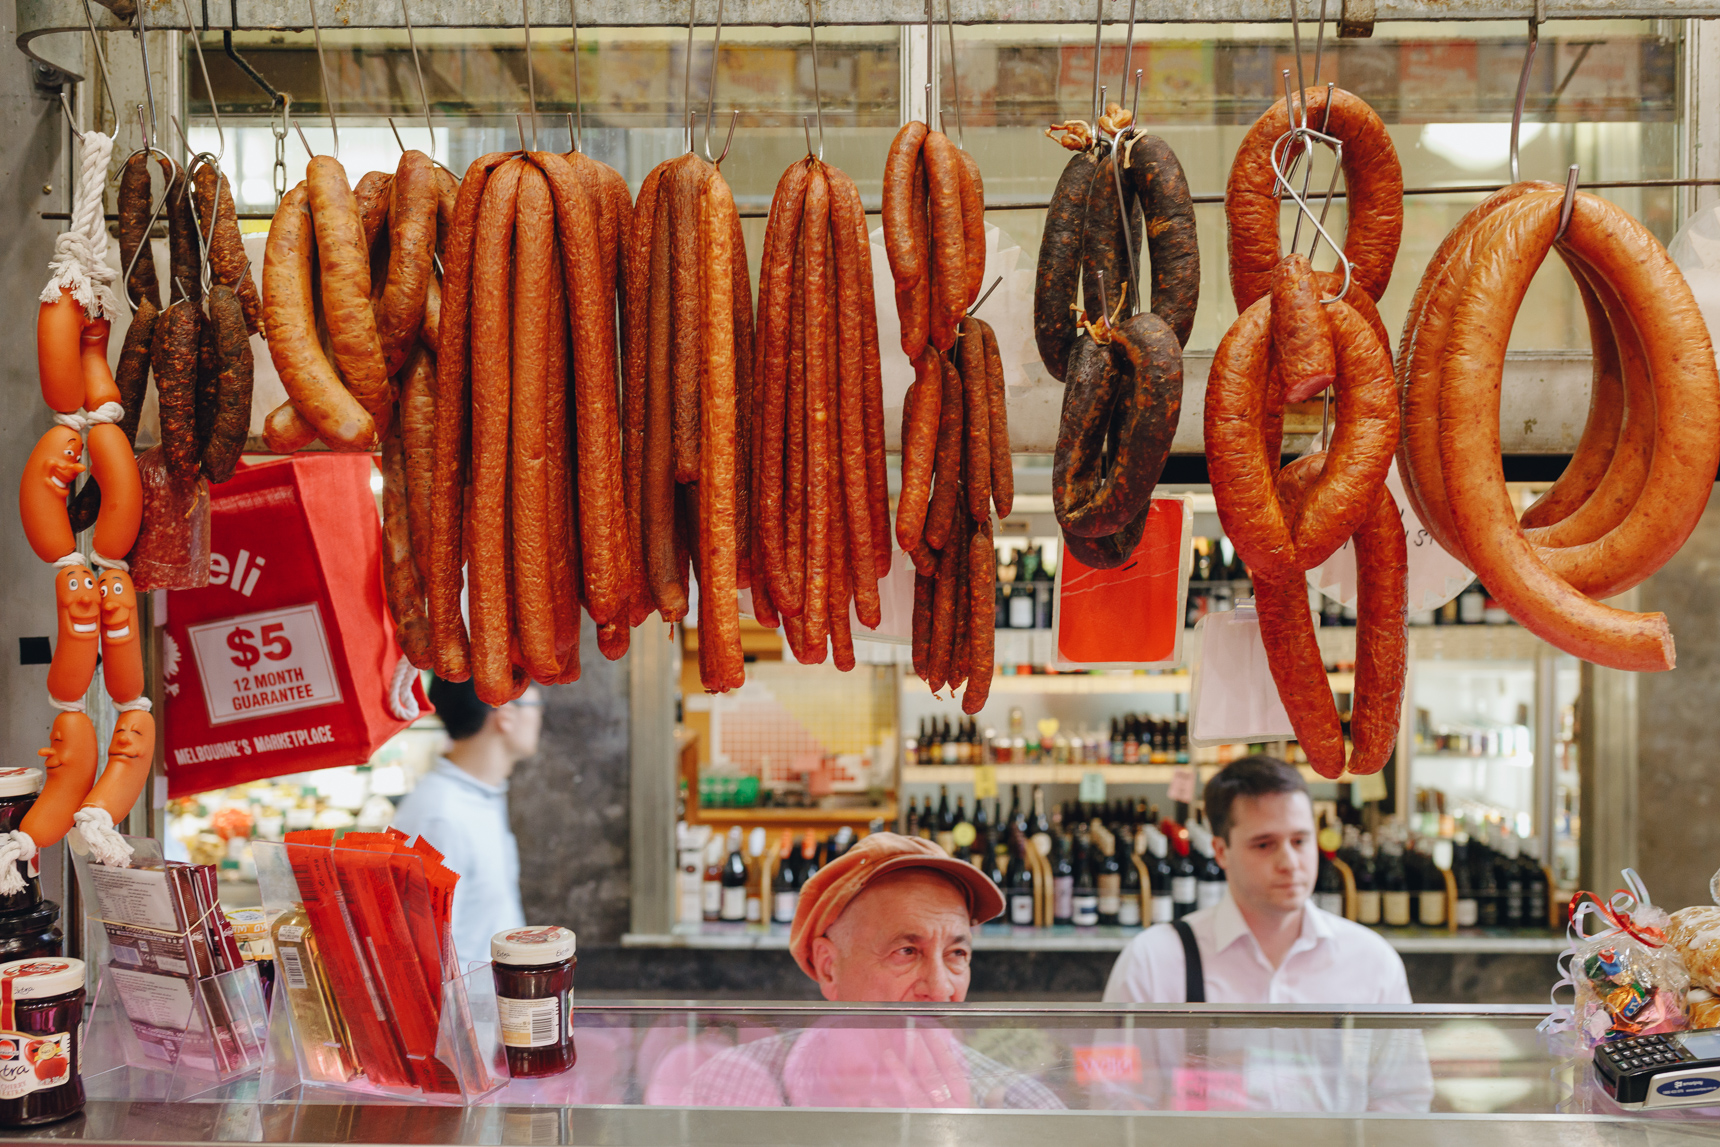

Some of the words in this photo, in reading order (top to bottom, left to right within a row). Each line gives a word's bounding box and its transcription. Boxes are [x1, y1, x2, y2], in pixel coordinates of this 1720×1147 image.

[209, 549, 266, 598] eli
[226, 622, 293, 672] $5
[233, 677, 252, 692] 12
[254, 667, 304, 689] MONTH
[232, 684, 314, 711] GUARANTEE
[174, 738, 252, 766] MELBOURNE'S
[253, 725, 335, 753] MARKETPLACE
[0, 1064, 30, 1081] tra
